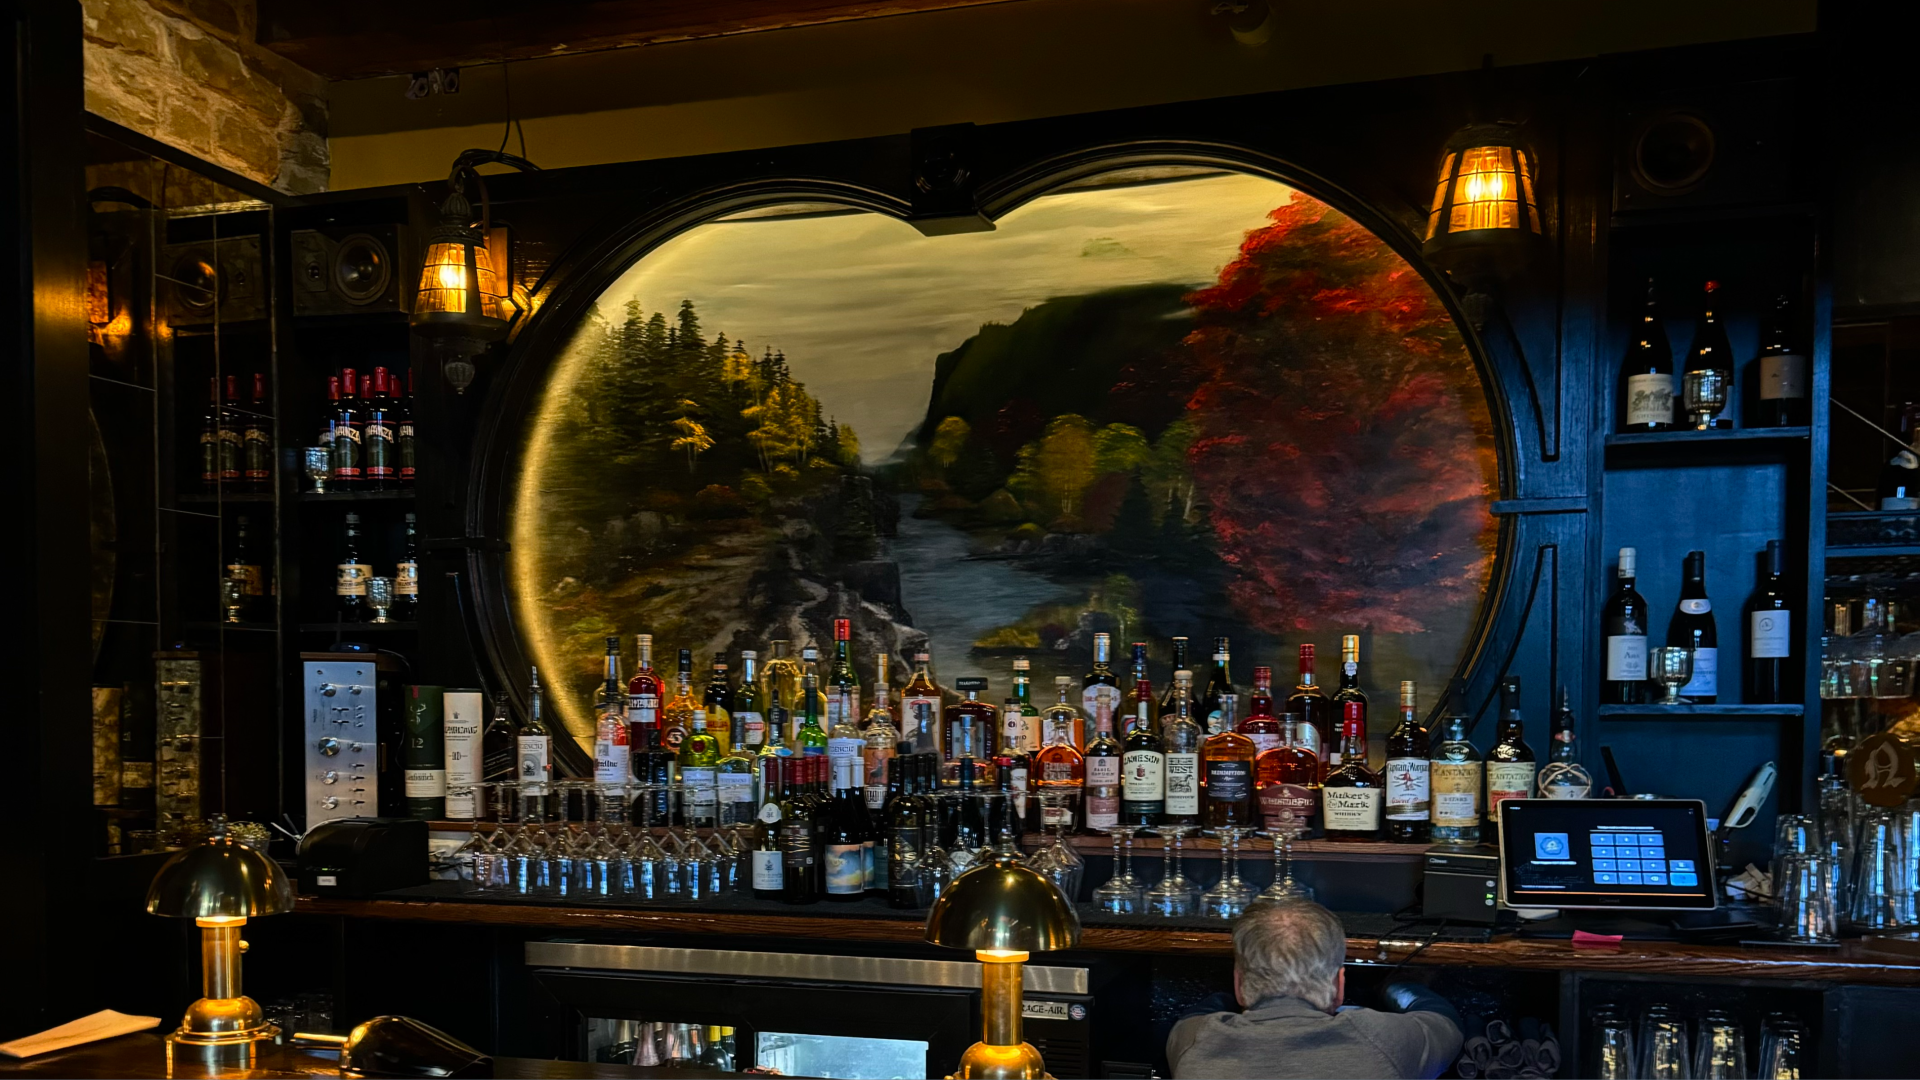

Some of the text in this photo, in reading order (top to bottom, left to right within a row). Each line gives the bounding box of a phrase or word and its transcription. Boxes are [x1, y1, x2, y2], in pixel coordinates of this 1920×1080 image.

[411, 738, 424, 749] 12
[1124, 755, 1160, 765] JAMESON
[1168, 766, 1194, 774] WEST
[1327, 792, 1370, 800] Maker's
[1337, 800, 1370, 809] Mark
